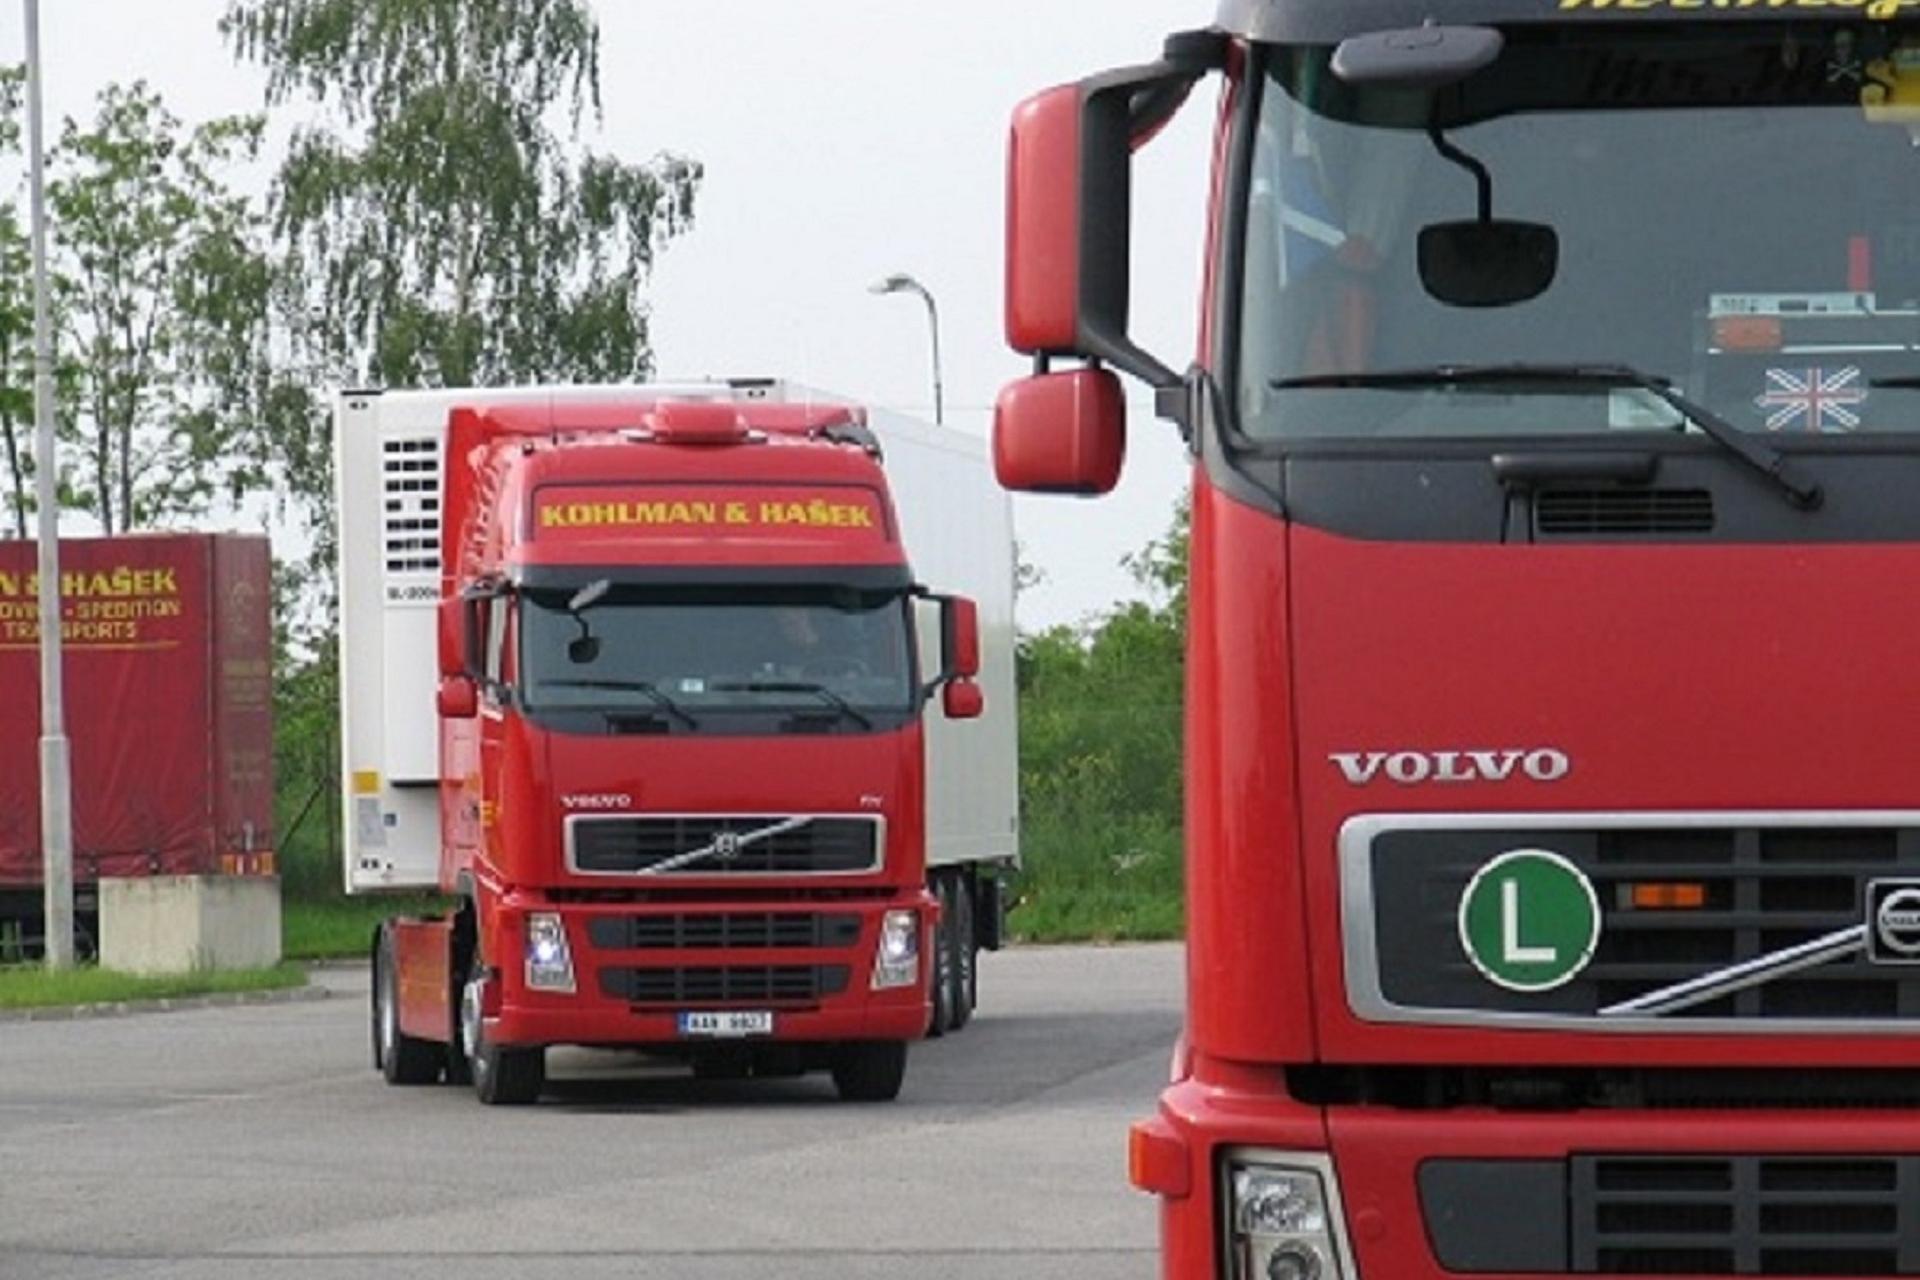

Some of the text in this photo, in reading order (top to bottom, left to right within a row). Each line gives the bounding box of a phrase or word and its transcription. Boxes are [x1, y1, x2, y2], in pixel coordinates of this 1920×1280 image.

[541, 500, 871, 527] KOHLMAN & HAŠEK
[62, 566, 176, 595] HAŠEK
[5, 621, 137, 639] TRASPORTS
[1328, 748, 1569, 783] VOLVO
[562, 795, 631, 808] VOLVO
[1503, 879, 1556, 961] L
